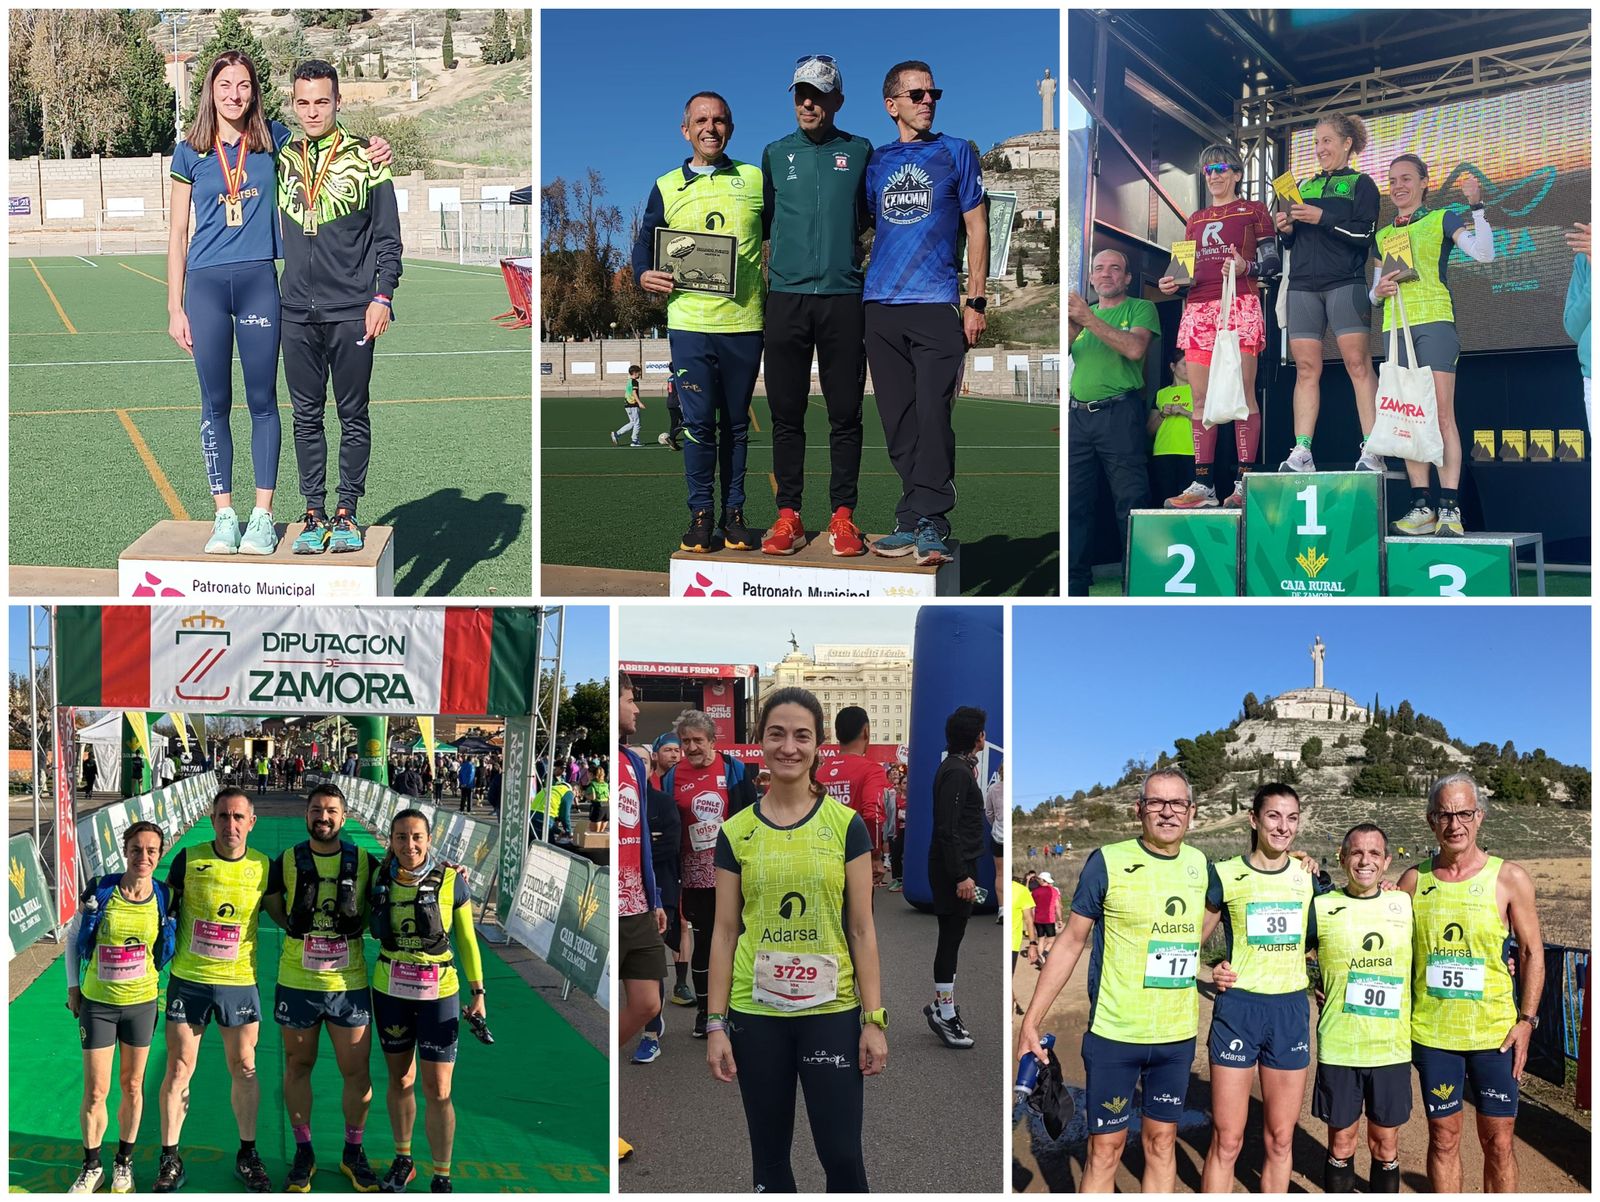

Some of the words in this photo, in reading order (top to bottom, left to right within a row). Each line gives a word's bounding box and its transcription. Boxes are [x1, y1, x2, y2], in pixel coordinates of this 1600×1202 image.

[1296, 485, 1327, 535] 1
[1164, 544, 1196, 594] 2
[1280, 580, 1306, 590] CAJA
[1309, 581, 1345, 592] RURAL
[1428, 563, 1467, 597] 3
[193, 580, 251, 594] Patronato
[256, 582, 315, 597] Municipal
[743, 582, 802, 597] Patronato
[658, 665, 688, 673] PONLE
[690, 666, 719, 674] FRENO
[250, 670, 415, 704] ZAMORA
[511, 732, 525, 825] RURAL
[695, 804, 719, 813] FRENO
[696, 799, 720, 808] PONLE
[695, 824, 718, 836] 10159
[520, 890, 535, 913] CAJA
[536, 898, 556, 924] RURAL
[1151, 922, 1195, 934] Adarsa
[1266, 916, 1287, 933] 39
[761, 928, 818, 943] Adarsa
[560, 926, 574, 948] CAJA
[574, 934, 598, 964] RURAL
[1432, 946, 1472, 958] Adarsa
[1169, 958, 1188, 976] 17
[1350, 957, 1393, 969] Adarsa
[773, 964, 818, 980] 3729
[1442, 970, 1464, 988] 55
[1364, 988, 1386, 1006] 90
[1220, 1051, 1246, 1062] Adarsa
